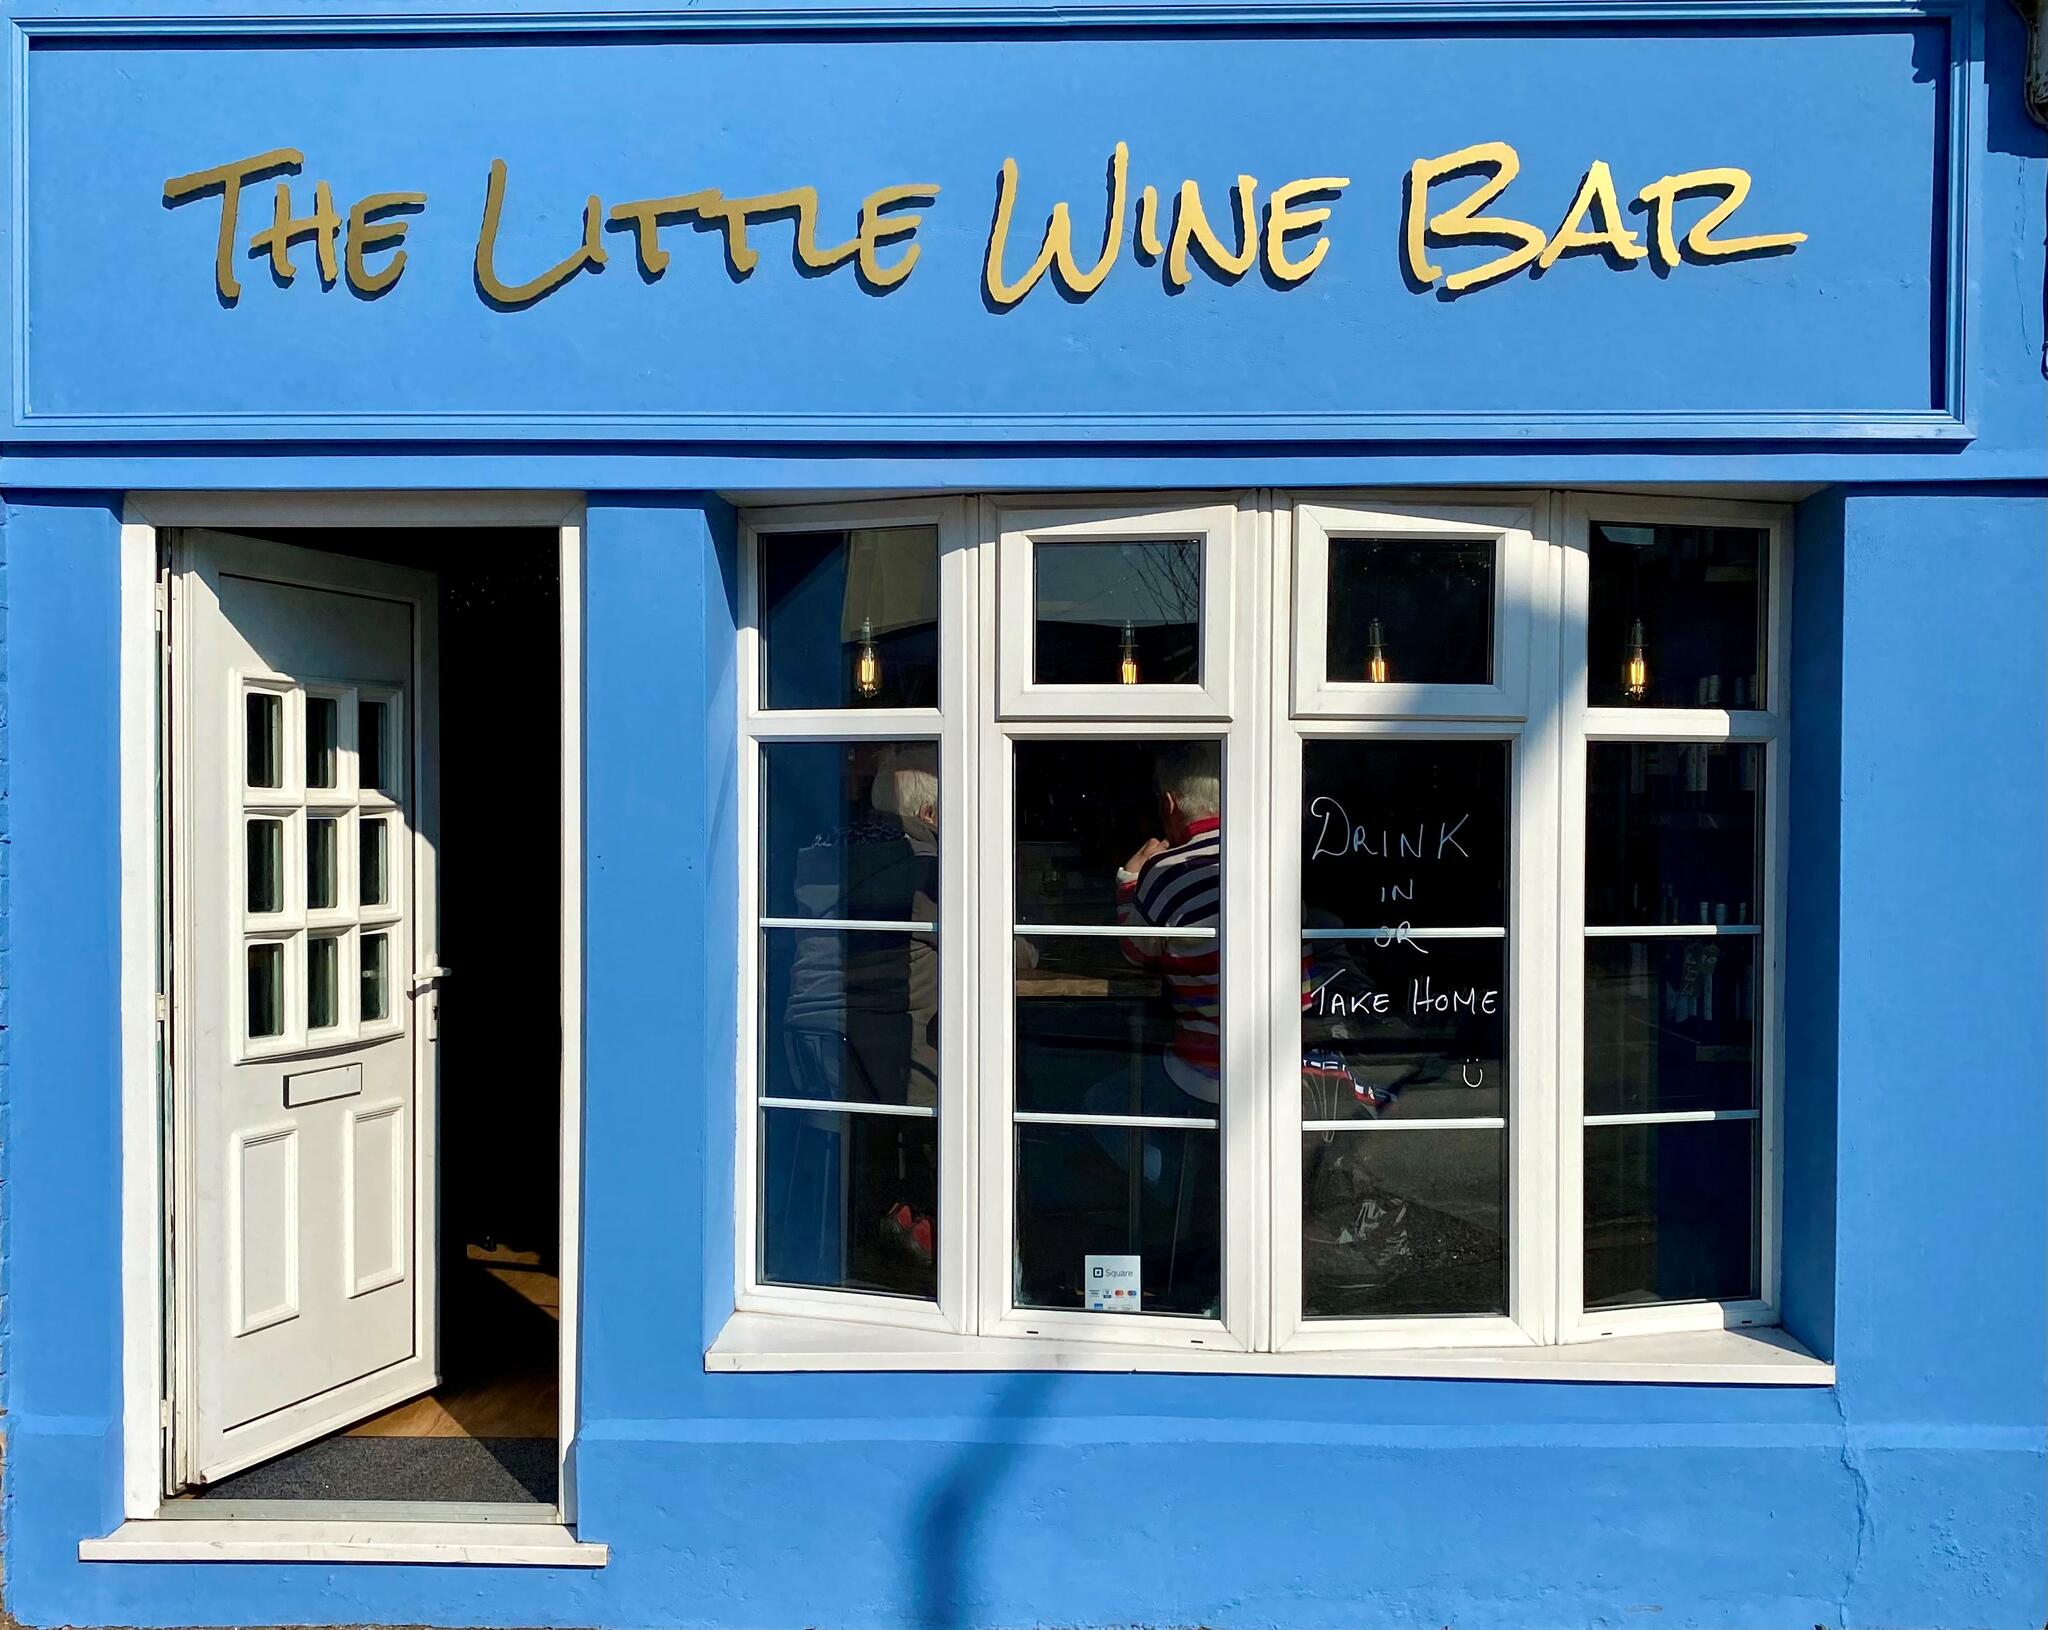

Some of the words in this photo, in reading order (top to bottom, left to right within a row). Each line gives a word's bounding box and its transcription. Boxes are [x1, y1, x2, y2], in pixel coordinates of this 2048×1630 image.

[164, 148, 427, 304] THE
[475, 158, 940, 308] LITTLE
[984, 141, 1350, 308] WINE
[1405, 141, 1808, 296] BAR
[1310, 796, 1470, 860] DRINK
[1380, 878, 1413, 903] IN
[1374, 920, 1429, 954] OR
[1310, 968, 1389, 1015] TAKE
[1413, 976, 1498, 1015] HOME
[1105, 1269, 1134, 1278] Square
